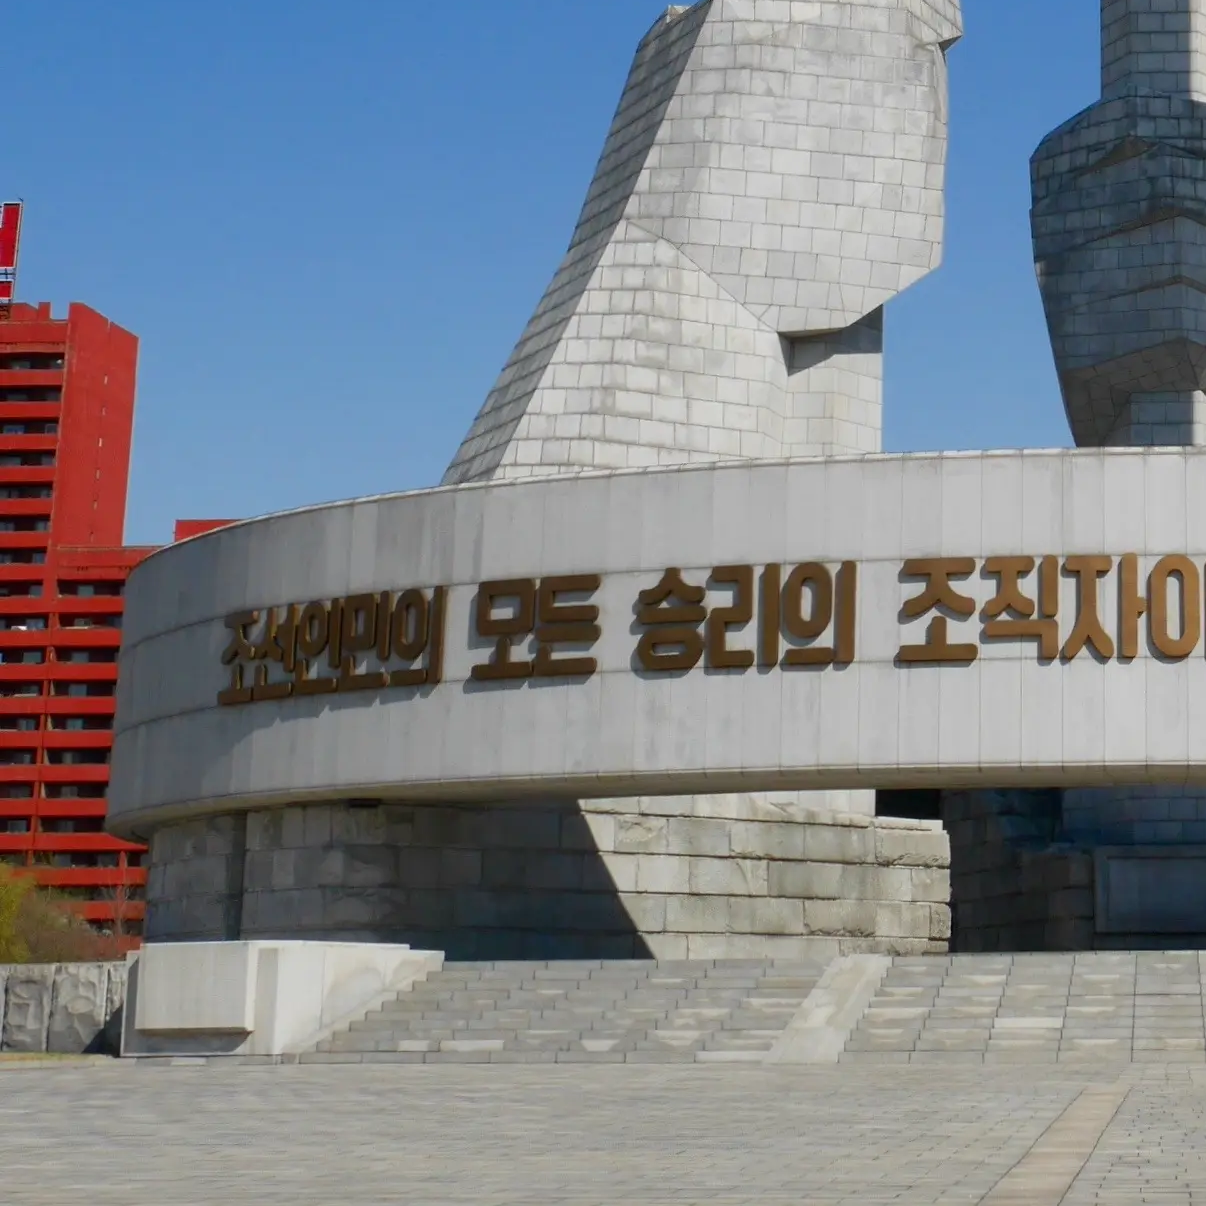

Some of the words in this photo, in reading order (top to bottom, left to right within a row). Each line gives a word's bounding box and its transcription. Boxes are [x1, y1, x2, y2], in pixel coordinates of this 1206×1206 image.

[218, 585, 448, 706] 조선인민의
[472, 574, 602, 680] 모든
[637, 560, 858, 671] 승리의
